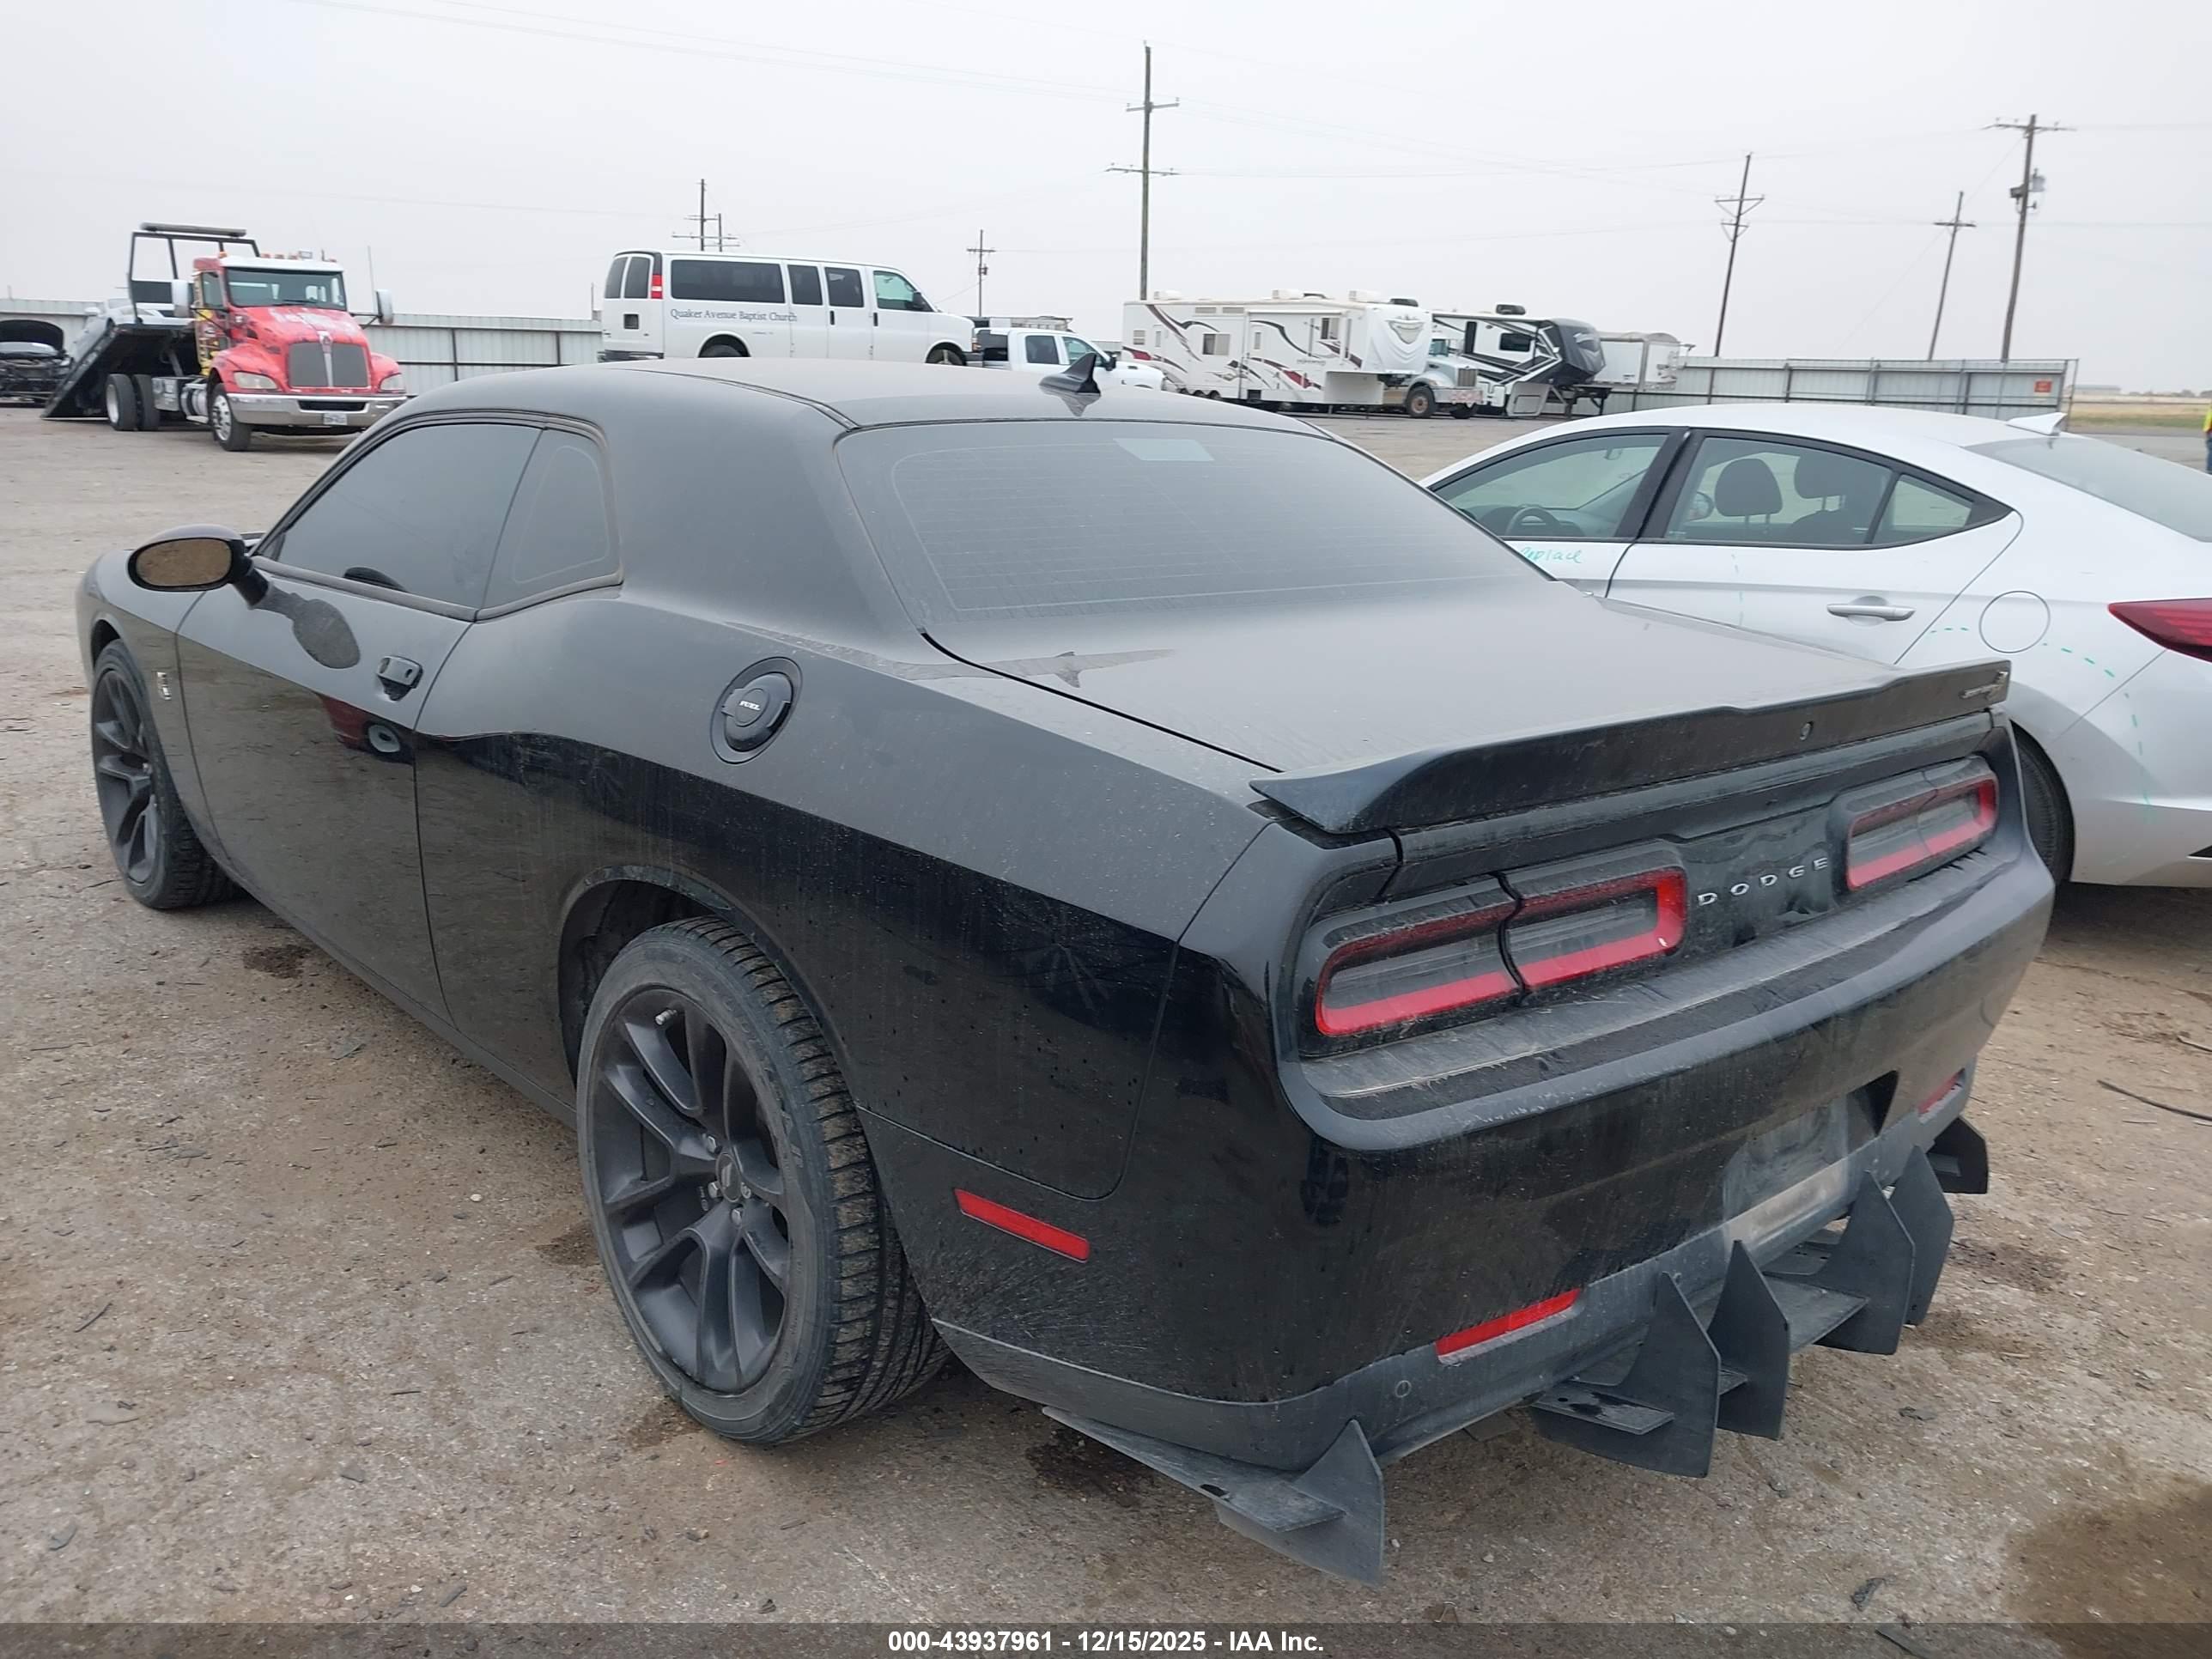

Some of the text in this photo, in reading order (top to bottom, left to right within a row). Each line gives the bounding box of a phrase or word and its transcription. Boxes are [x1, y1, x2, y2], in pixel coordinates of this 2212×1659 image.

[670, 308, 798, 322] Quaker Avenue Baptist Church
[738, 701, 761, 711] FUEL
[1697, 857, 1828, 907] DODGE
